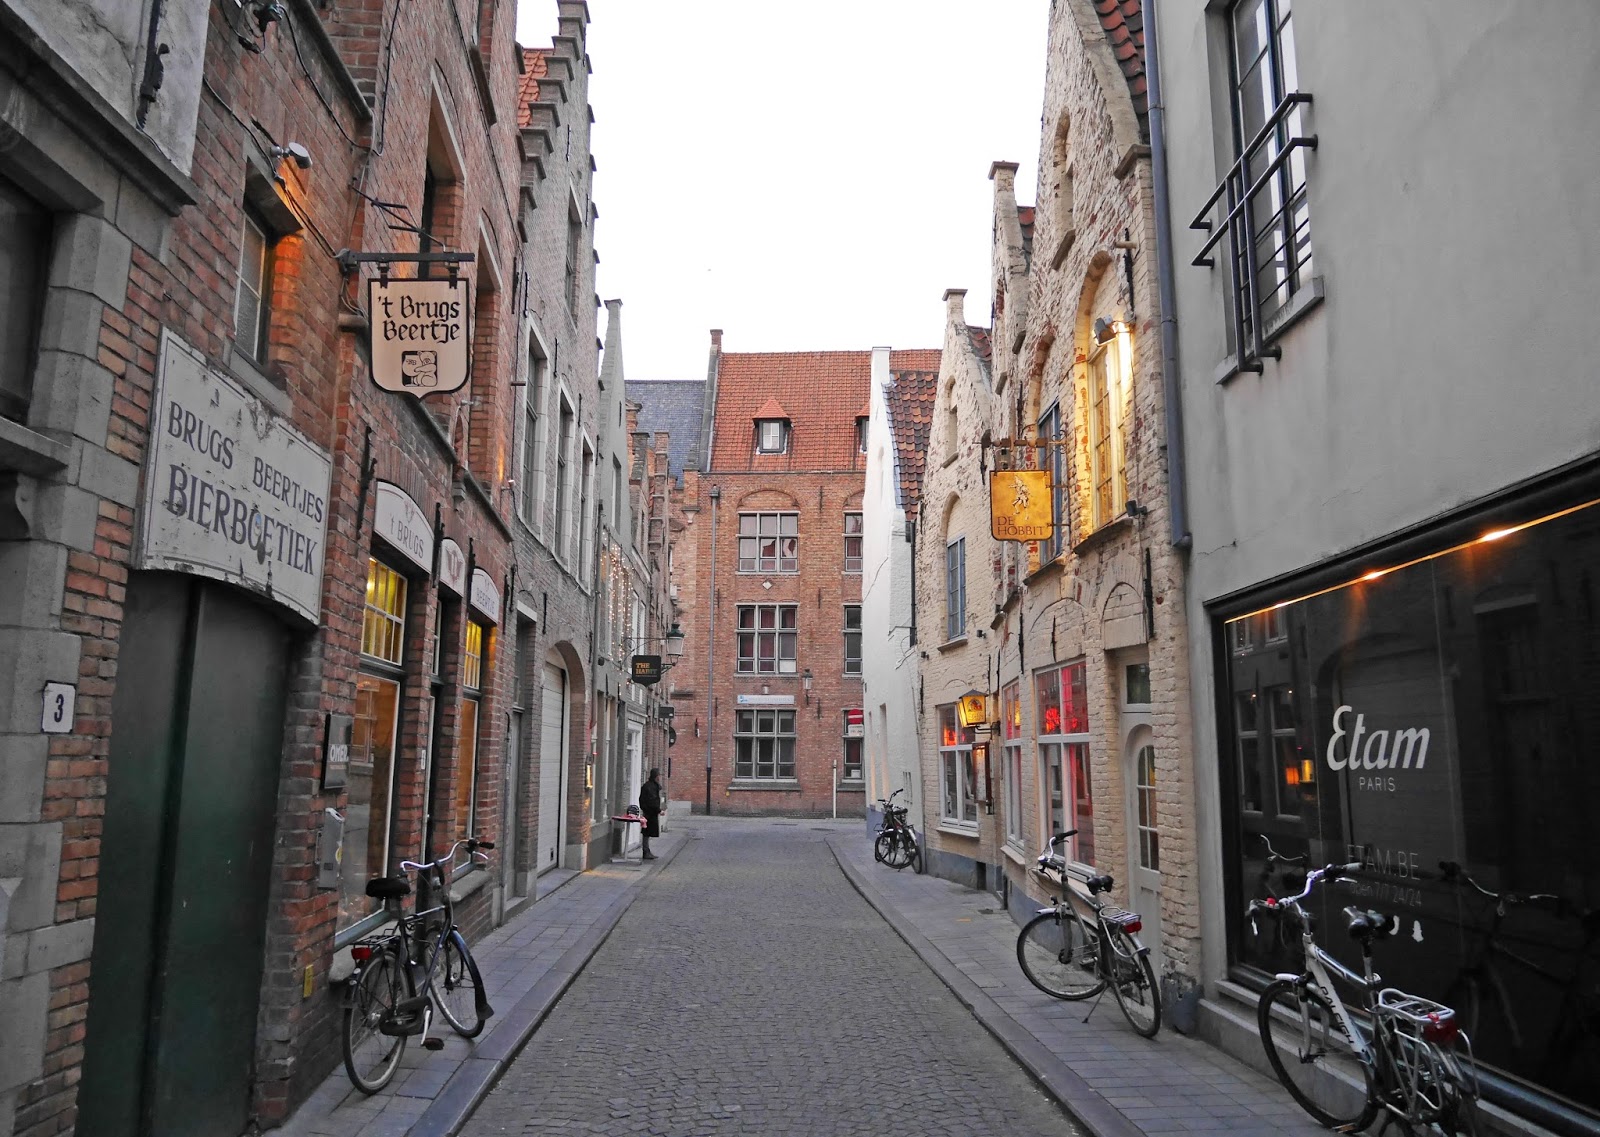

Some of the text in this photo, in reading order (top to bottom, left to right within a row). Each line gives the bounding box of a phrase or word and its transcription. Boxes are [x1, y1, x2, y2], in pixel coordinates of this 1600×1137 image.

[378, 295, 461, 322] 't Brugs
[383, 320, 460, 344] Beertje
[167, 400, 324, 524] BRUGS BEERTJES
[166, 464, 318, 575] BIERBOETIEK
[997, 516, 1015, 526] DE
[997, 526, 1045, 536] HOBBIT
[397, 520, 424, 559] BRUGS
[54, 693, 64, 723] 3
[1326, 704, 1431, 771] Etam
[1359, 776, 1396, 792] PARIS
[1347, 844, 1421, 881] ETAM.BE
